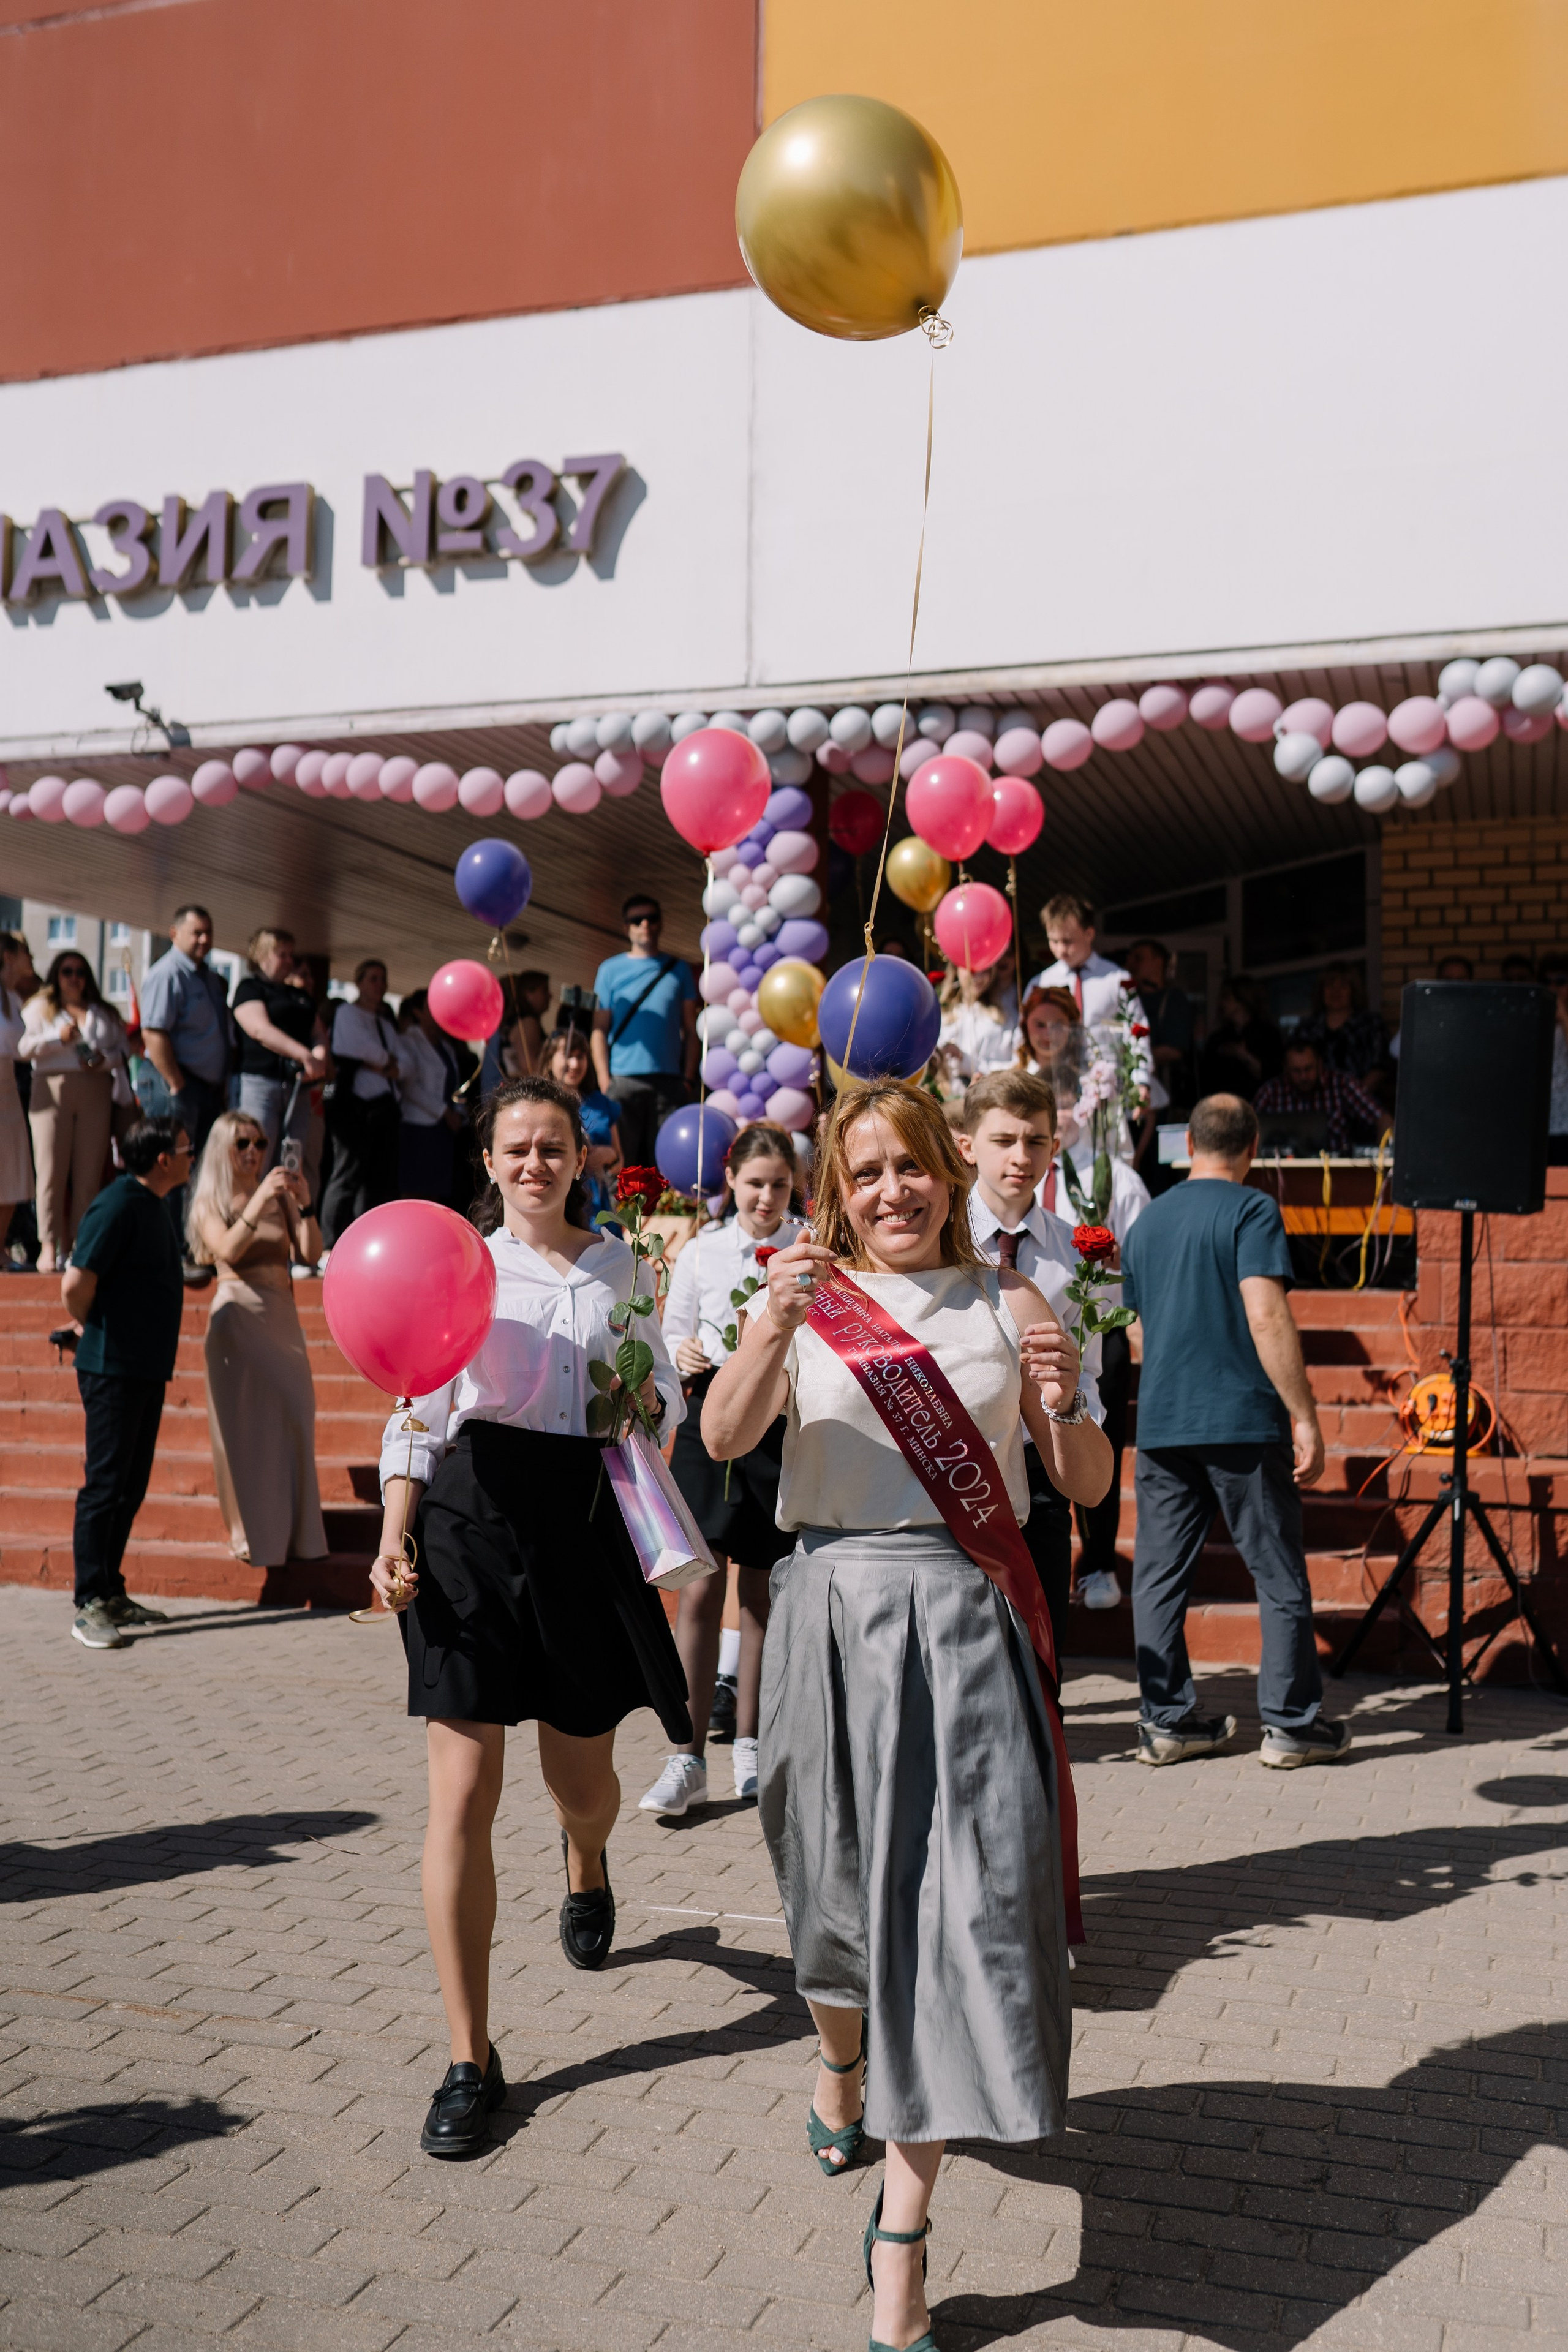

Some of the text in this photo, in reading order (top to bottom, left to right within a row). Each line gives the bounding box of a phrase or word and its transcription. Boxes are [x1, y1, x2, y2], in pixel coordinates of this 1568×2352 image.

[361, 453, 626, 567] №37
[806, 1306, 938, 1481] СС ГИМНАЗИЯ № 37 Г. МИНСКА
[870, 1323, 908, 1355] НАТАЛЬЯ
[903, 1355, 953, 1430] НИКОЛАЕВНА
[934, 1439, 998, 1529] 2024
